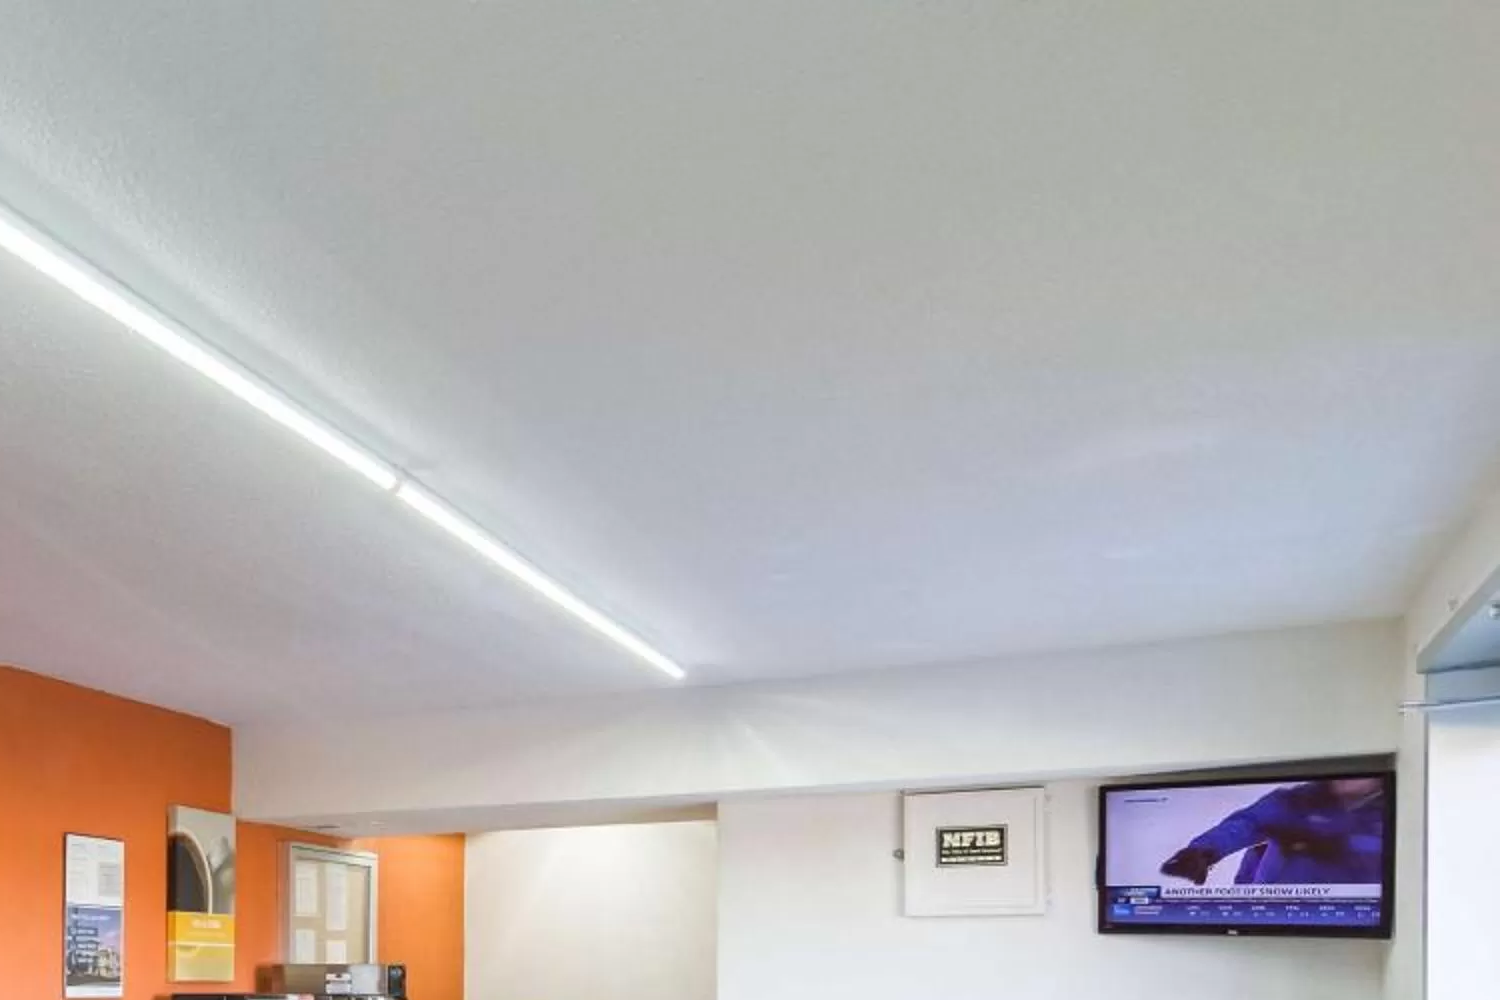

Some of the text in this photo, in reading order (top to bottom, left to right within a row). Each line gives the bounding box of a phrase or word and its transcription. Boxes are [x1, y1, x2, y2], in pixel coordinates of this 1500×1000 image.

[943, 831, 1000, 848] NFIB
[1164, 887, 1213, 896] ANOTHER
[1258, 887, 1293, 896] SNOW
[1295, 887, 1331, 896] LIKELY
